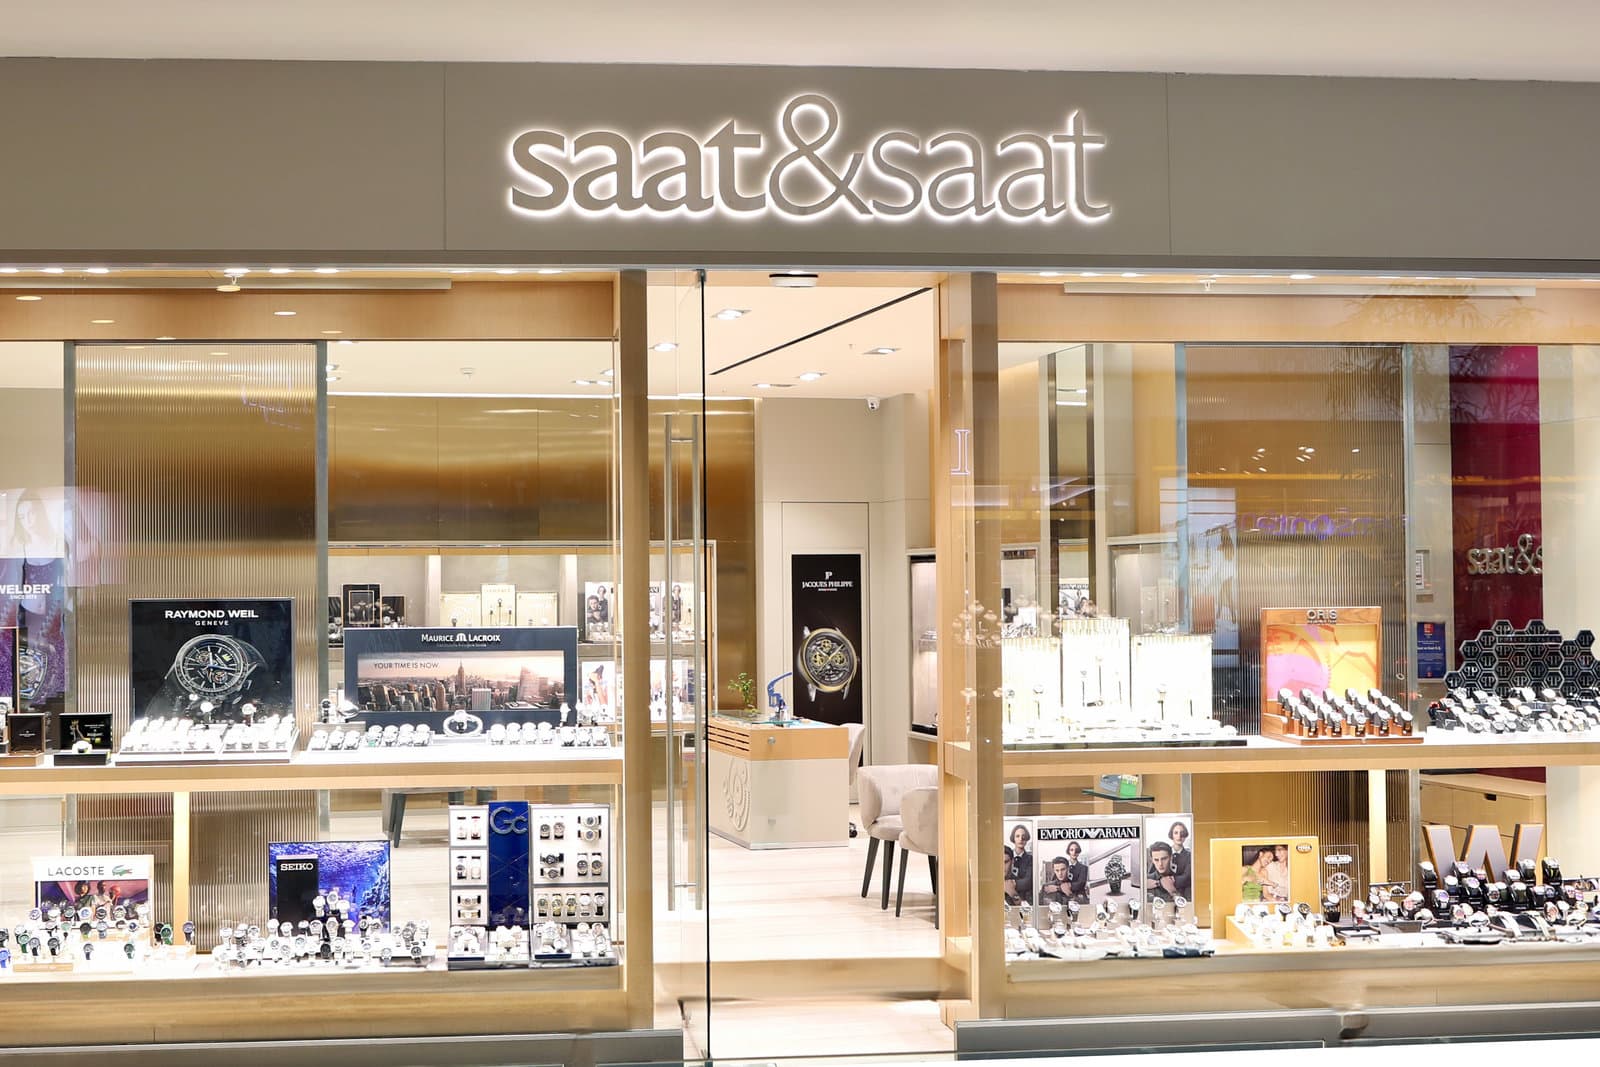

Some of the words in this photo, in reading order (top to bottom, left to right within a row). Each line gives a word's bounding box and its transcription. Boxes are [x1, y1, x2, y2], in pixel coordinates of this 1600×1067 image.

[509, 94, 1112, 219] saat&saat
[164, 610, 225, 619] RAYMOND
[227, 610, 259, 618] WEIL
[1307, 609, 1338, 620] ORIS
[490, 806, 528, 835] Gc
[1040, 828, 1086, 840] EMPORIO
[1099, 827, 1137, 838] ARMANI
[47, 866, 105, 877] LACOSTE
[280, 862, 314, 871] SEIKO
